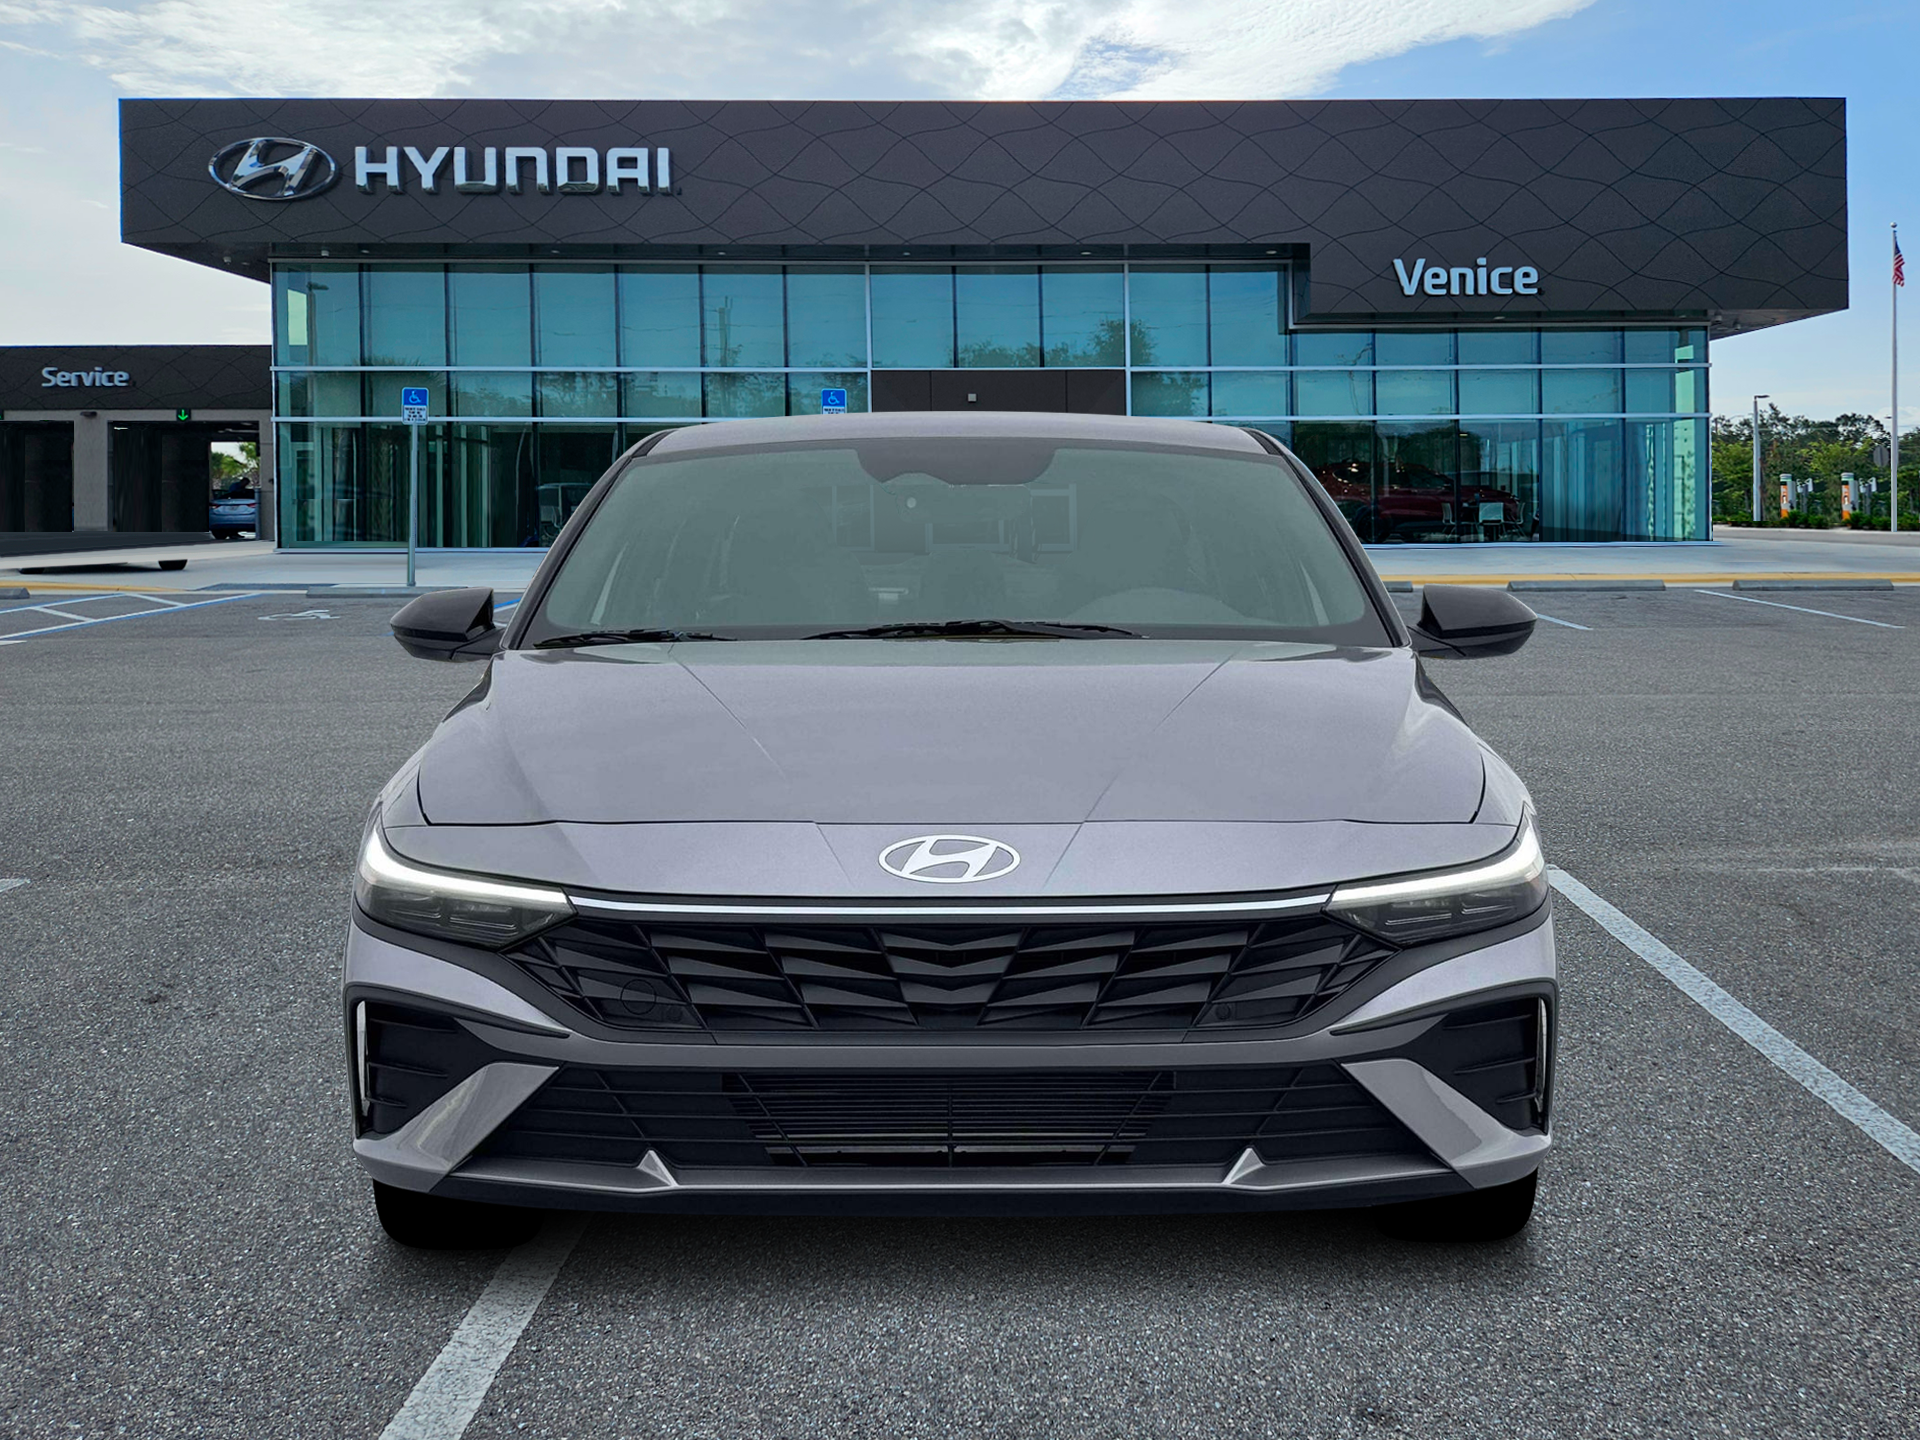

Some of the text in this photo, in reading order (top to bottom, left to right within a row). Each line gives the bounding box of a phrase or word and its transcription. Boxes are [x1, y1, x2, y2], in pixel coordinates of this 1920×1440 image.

[355, 146, 671, 193] HYUNDAI
[1393, 257, 1539, 296] Venice
[41, 366, 130, 388] Service
